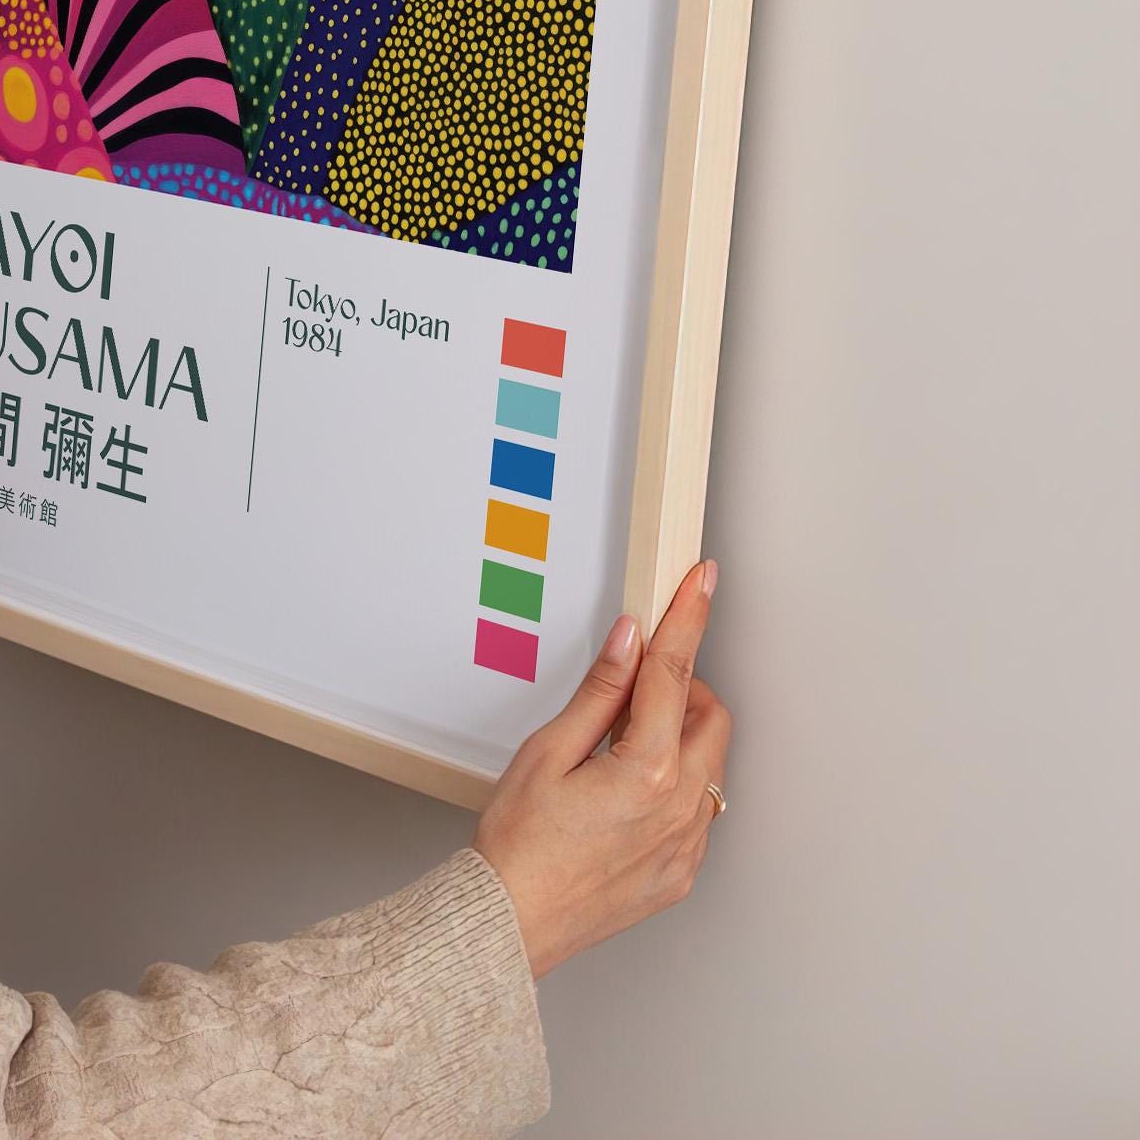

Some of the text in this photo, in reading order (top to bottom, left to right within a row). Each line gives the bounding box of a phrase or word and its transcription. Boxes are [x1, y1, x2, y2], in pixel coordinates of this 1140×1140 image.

[282, 316, 343, 358] 1984
[284, 276, 451, 343] Tokyo, Japan
[41, 402, 149, 504] 彌生
